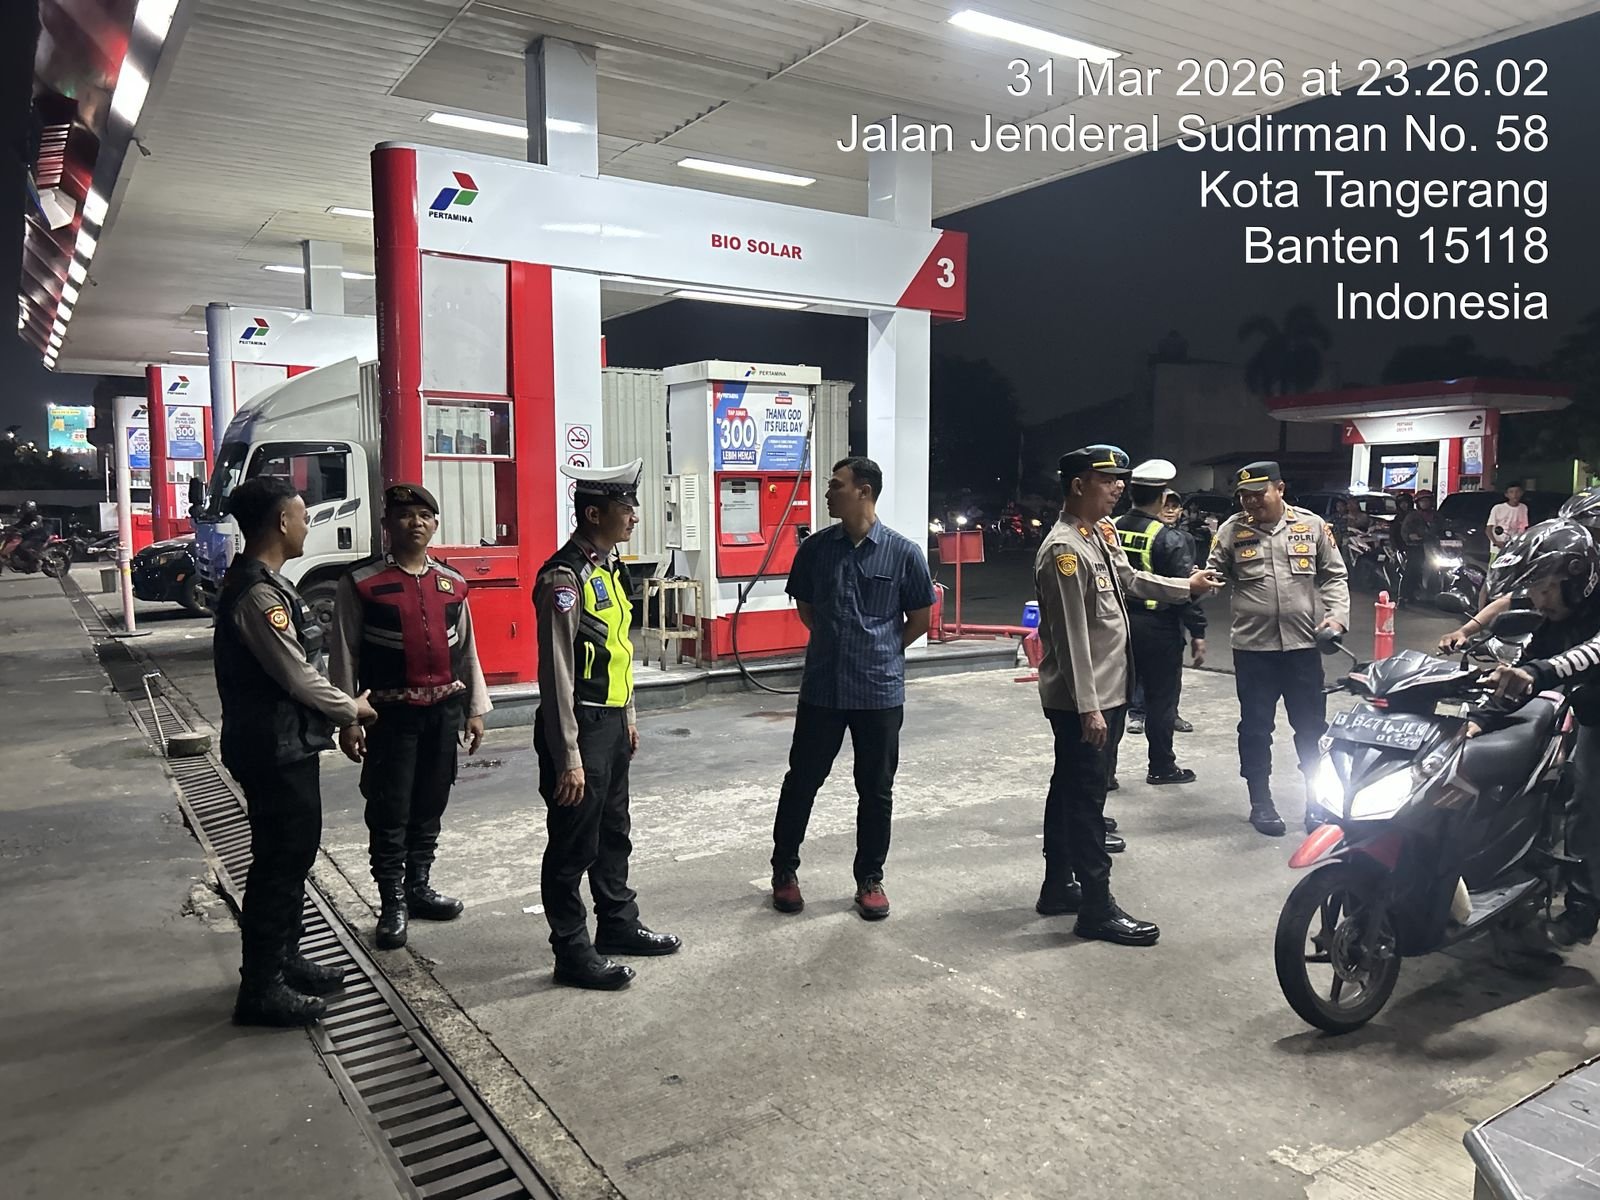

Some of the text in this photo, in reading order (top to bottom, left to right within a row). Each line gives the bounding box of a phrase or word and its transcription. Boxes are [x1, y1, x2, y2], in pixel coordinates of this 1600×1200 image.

[428, 210, 473, 223] PERTAMINA
[711, 233, 803, 260] BIO SOLAR
[936, 257, 956, 289] 3
[765, 408, 802, 421] THANK GOD
[176, 426, 195, 437] 300
[720, 417, 755, 450] 300
[764, 421, 803, 433] IT'S FUEL DAY
[1345, 426, 1353, 437] 7
